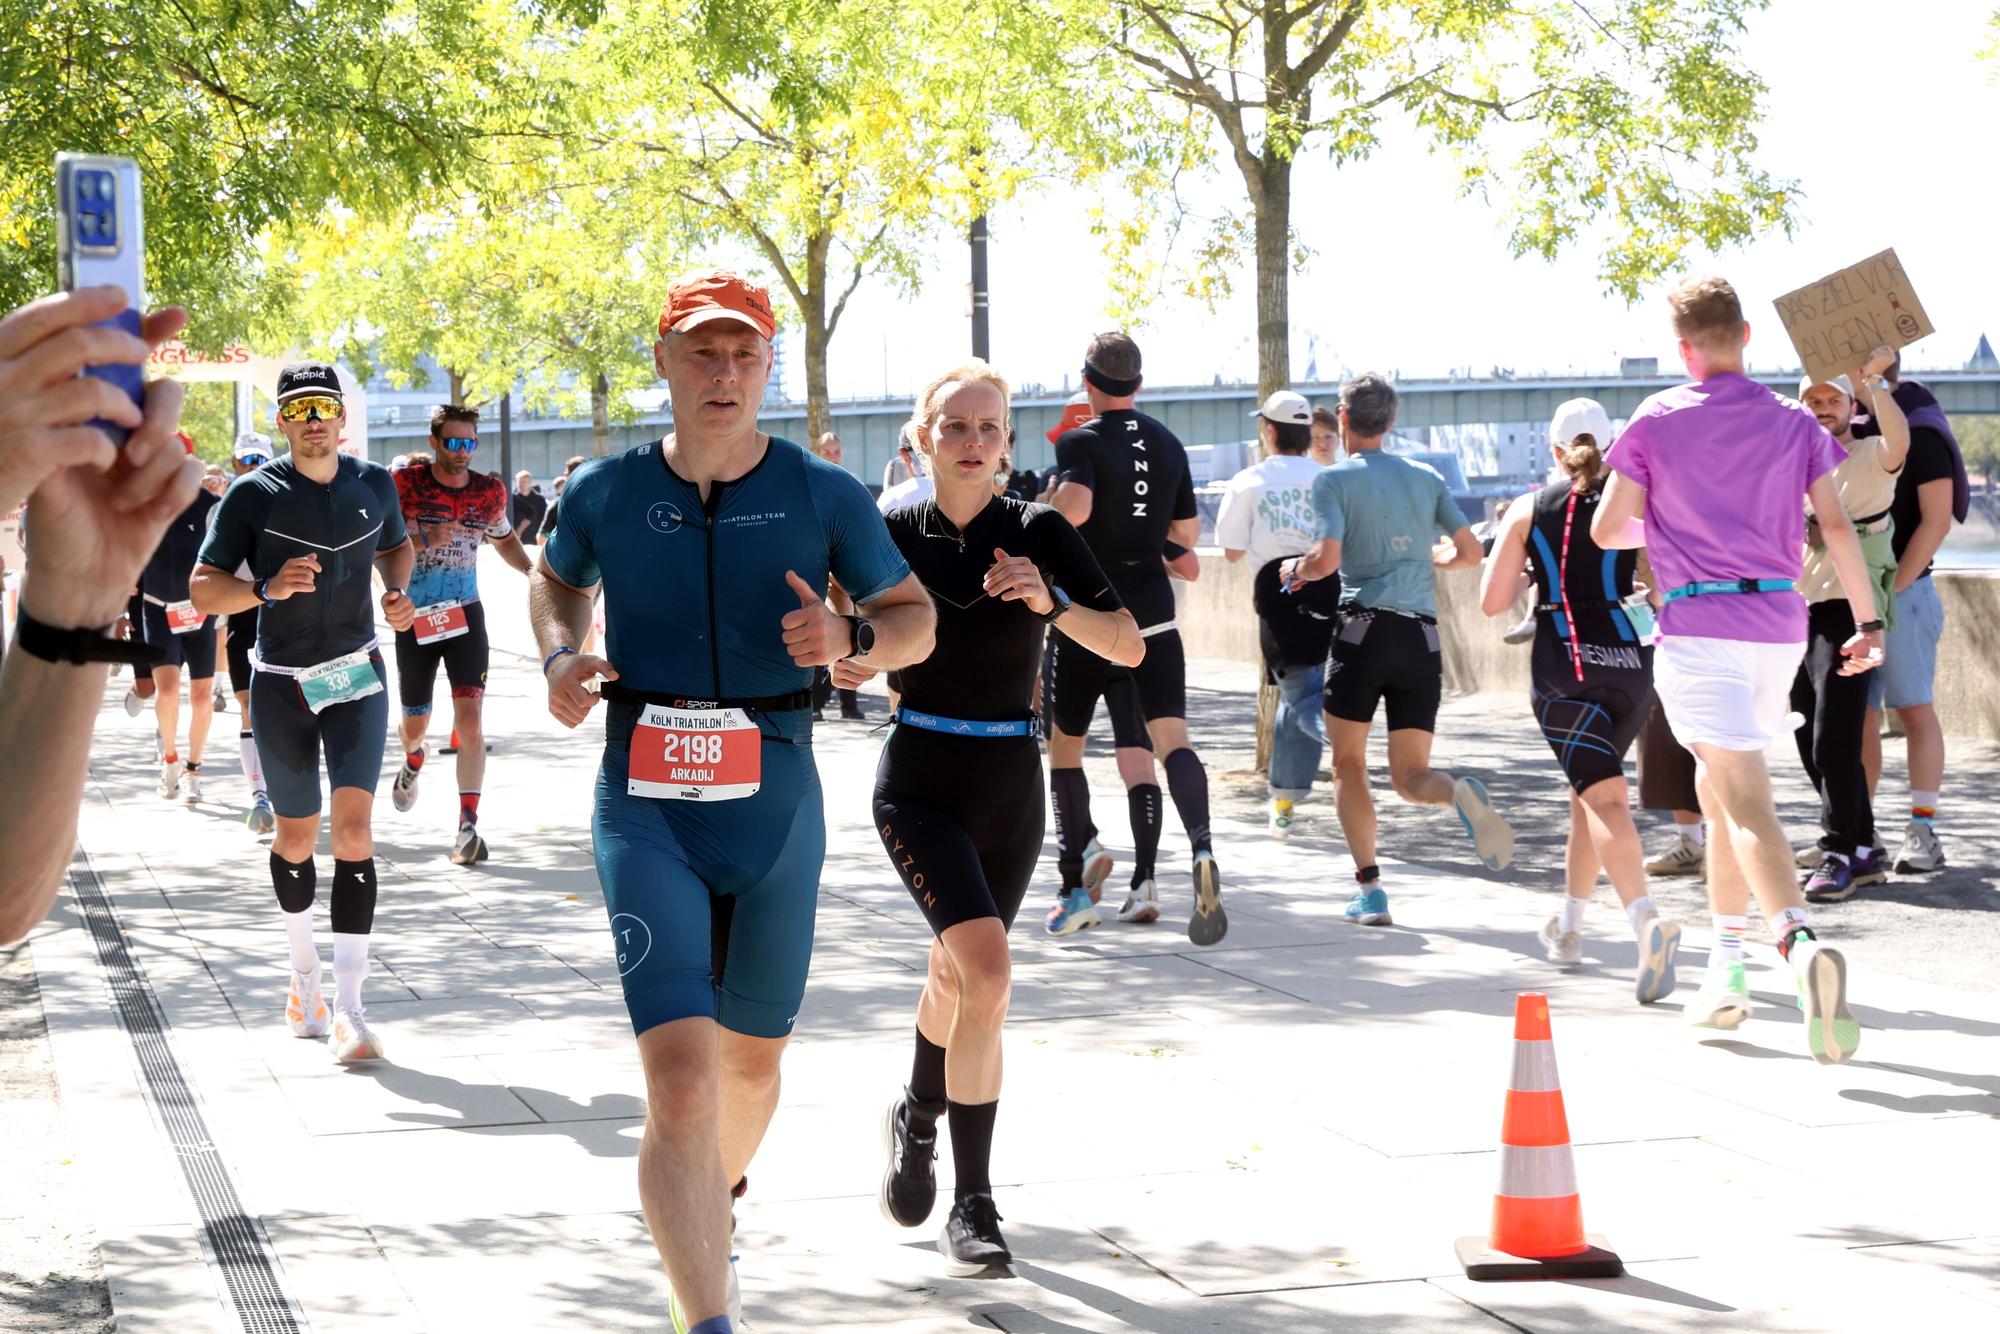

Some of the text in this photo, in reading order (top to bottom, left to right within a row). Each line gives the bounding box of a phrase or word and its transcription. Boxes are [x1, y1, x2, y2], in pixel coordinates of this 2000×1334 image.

[1776, 292, 1817, 329] DAS
[1814, 273, 1865, 316] ZIEL
[1124, 420, 1149, 517] RYZON
[427, 611, 450, 627] 1125
[325, 671, 352, 692] 338
[650, 713, 722, 729] KÖLN TRIATHLON
[909, 714, 937, 728] sailfish
[986, 723, 1015, 735] sailfish
[664, 733, 723, 764] 2198
[670, 767, 714, 782] ARKADIJ
[881, 823, 936, 910] RYZON
